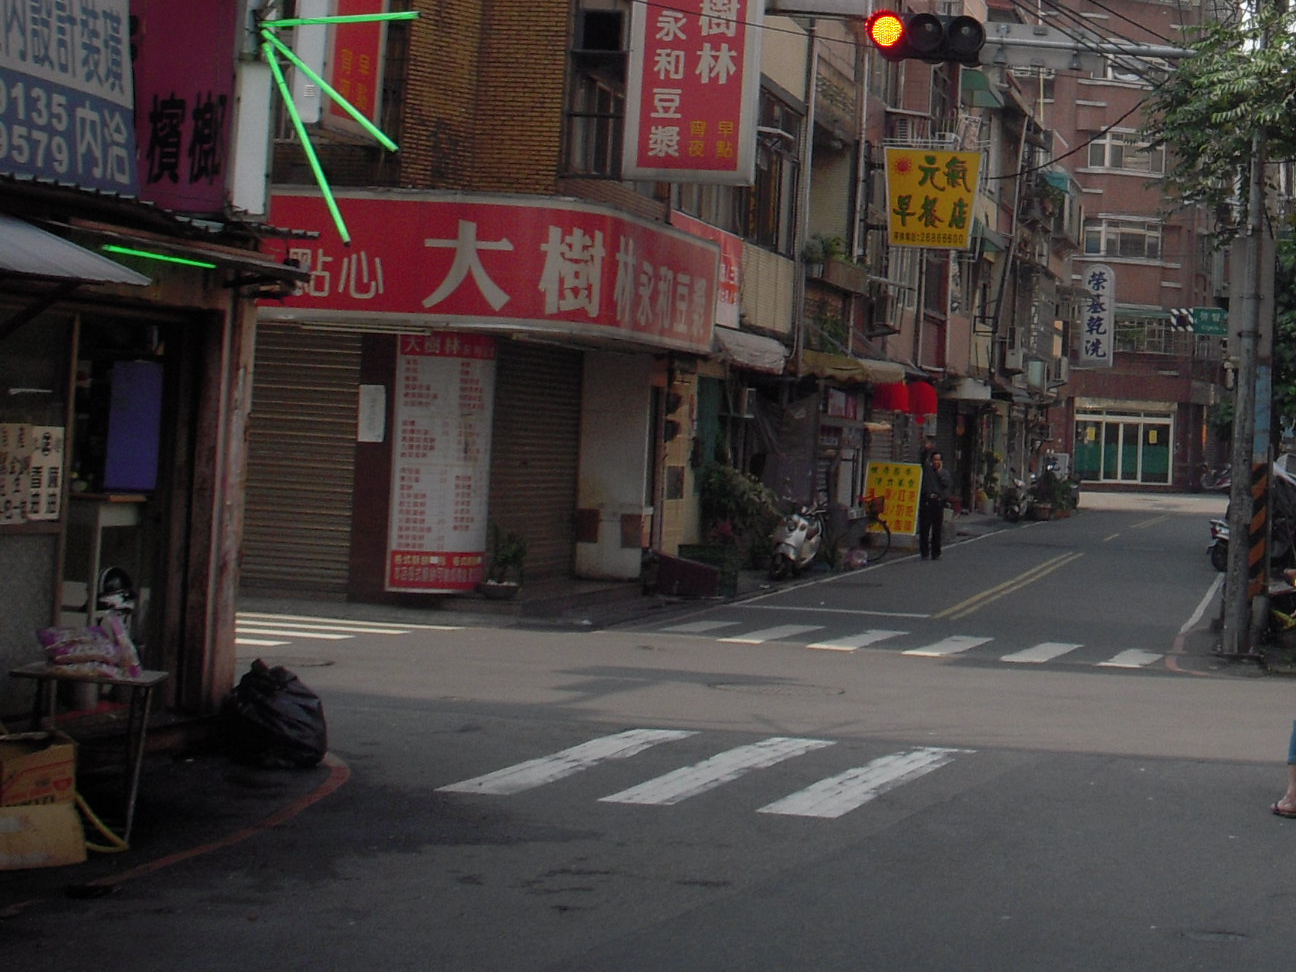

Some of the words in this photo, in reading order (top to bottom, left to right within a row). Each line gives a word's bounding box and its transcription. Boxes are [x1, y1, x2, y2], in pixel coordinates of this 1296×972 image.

[647, 10, 688, 157] 永和豆漿
[689, 120, 706, 157] 宵夜
[717, 121, 733, 158] 早點
[918, 155, 971, 192] 元氣
[893, 194, 969, 229] 早餐店
